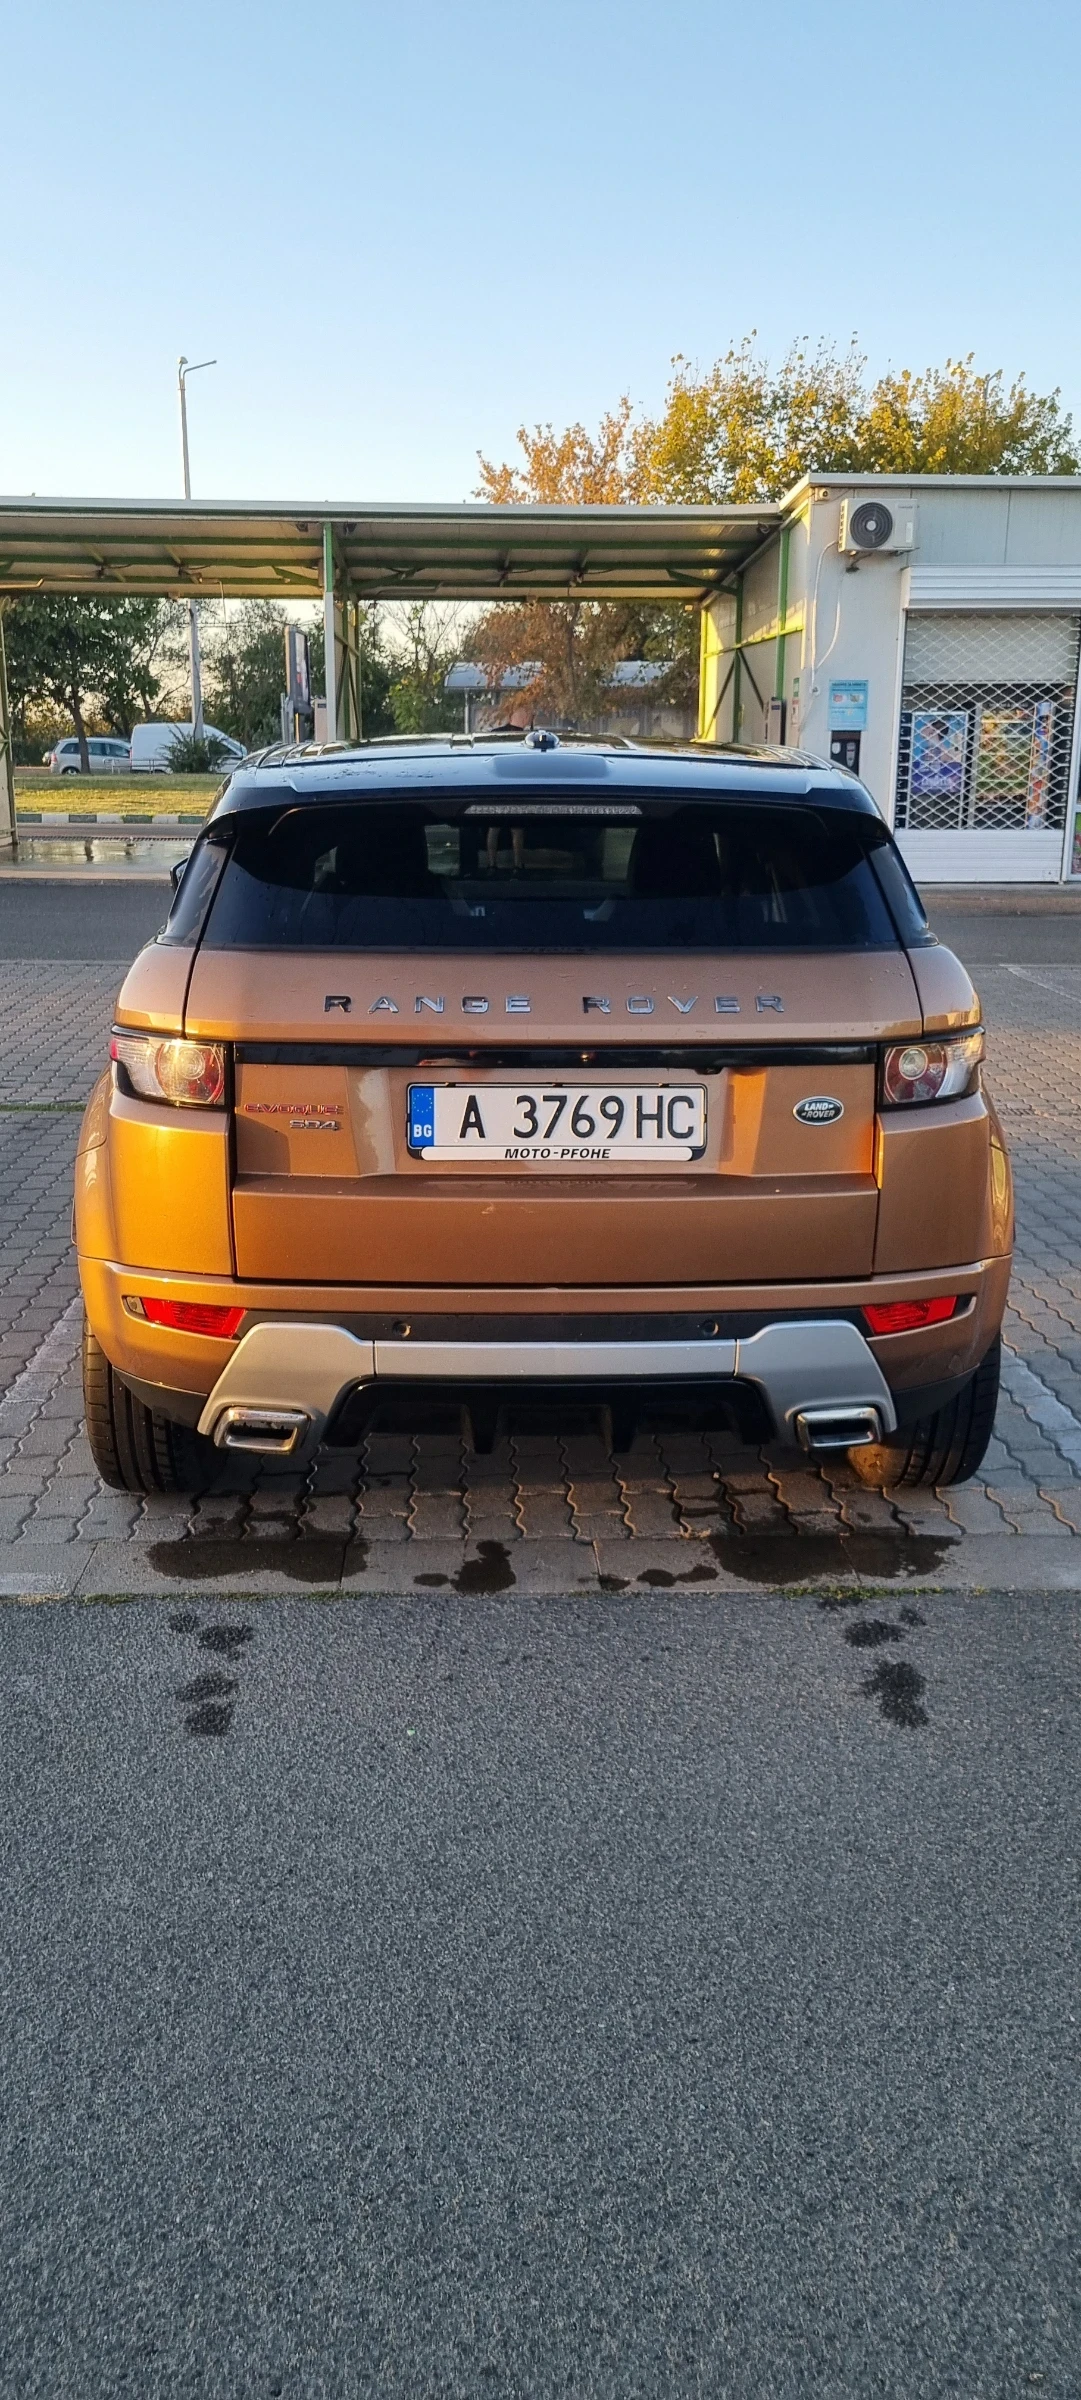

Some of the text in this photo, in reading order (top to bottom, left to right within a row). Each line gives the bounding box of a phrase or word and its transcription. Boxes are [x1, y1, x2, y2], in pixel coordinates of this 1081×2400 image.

[323, 995, 785, 1014] RANGE ROVER
[244, 1104, 339, 1115] EVOQUE
[804, 1102, 829, 1111] LAND
[459, 1094, 486, 1139] A
[806, 1110, 835, 1118] ROVER
[289, 1119, 339, 1130] SD4
[413, 1124, 433, 1138] BG
